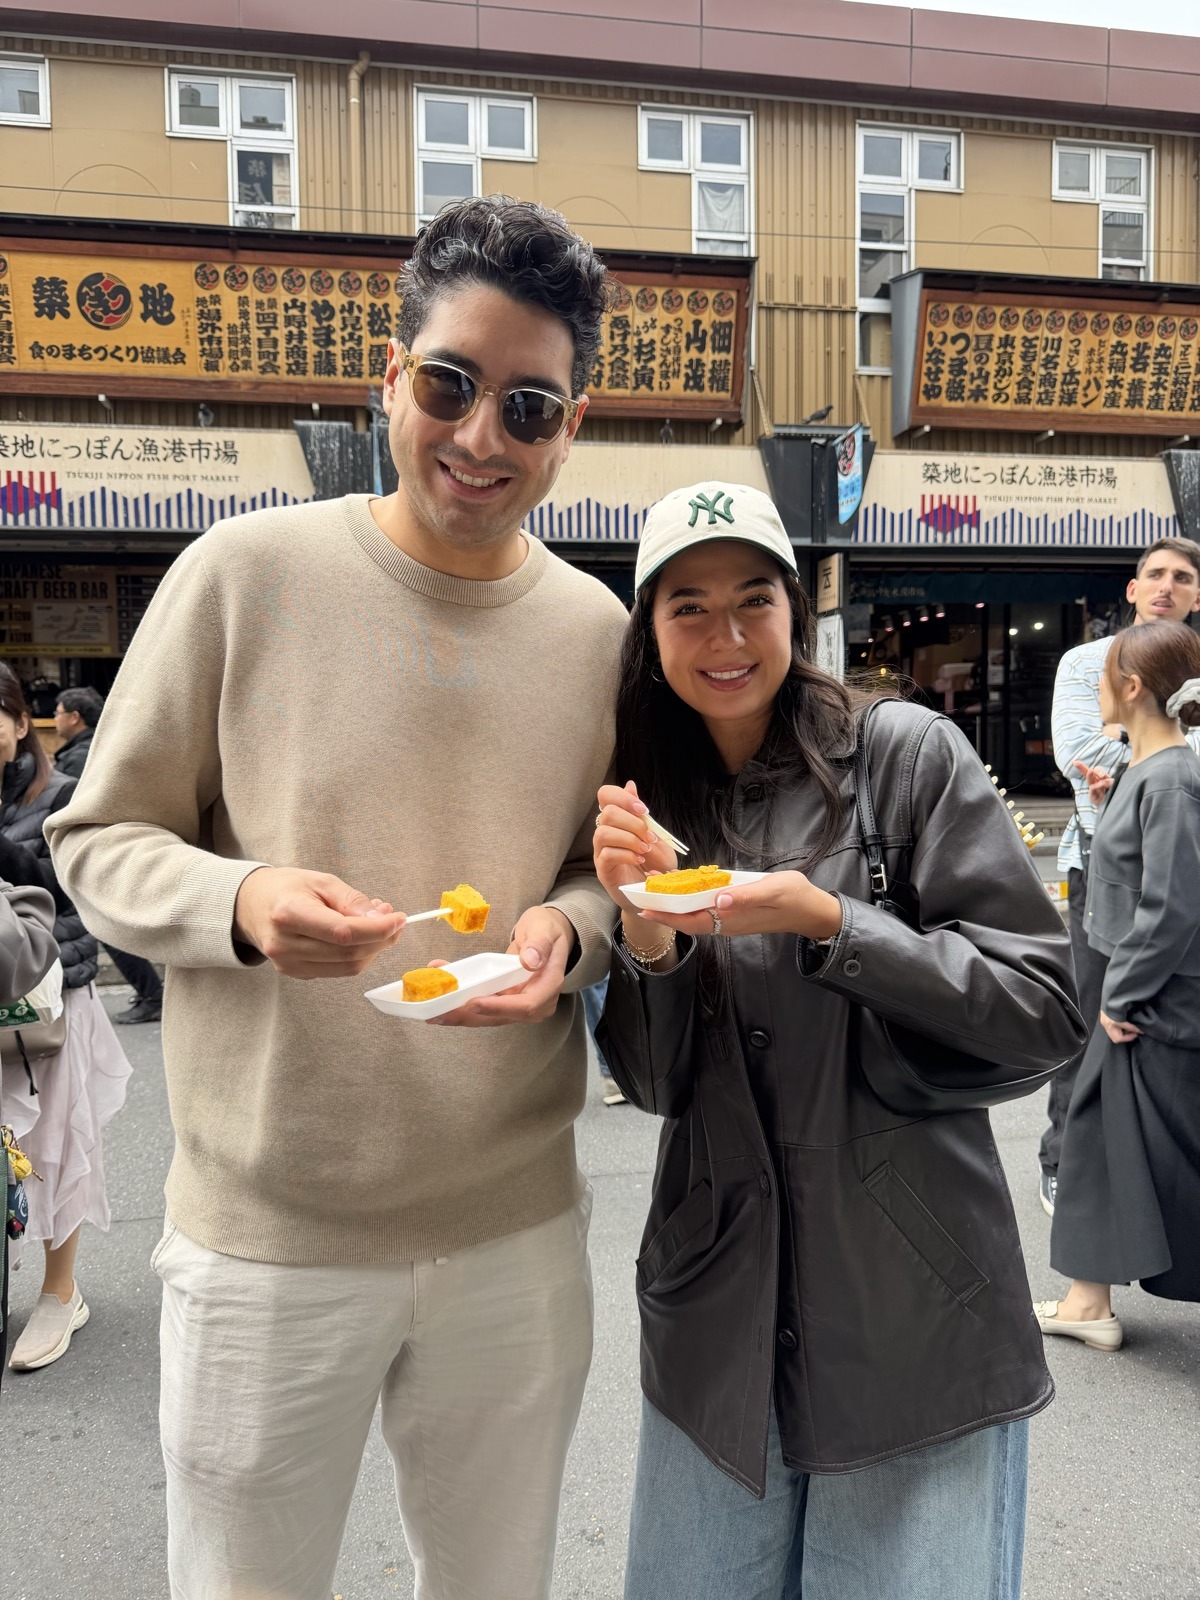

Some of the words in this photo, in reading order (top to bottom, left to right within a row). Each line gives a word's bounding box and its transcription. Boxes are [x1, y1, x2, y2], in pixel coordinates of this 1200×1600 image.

[29, 341, 187, 365] 食のまちづくり協議会
[65, 470, 104, 480] TSUKIJI
[106, 472, 143, 480] NIPPON
[146, 472, 170, 481] FISH
[172, 473, 197, 482] PORT
[200, 474, 240, 483] MARKET
[922, 462, 1118, 489] 築地にっぽん漁港市場
[688, 491, 735, 527] NY
[0, 563, 62, 579] APANESE
[43, 581, 77, 600] BEER
[81, 582, 108, 600] BAR
